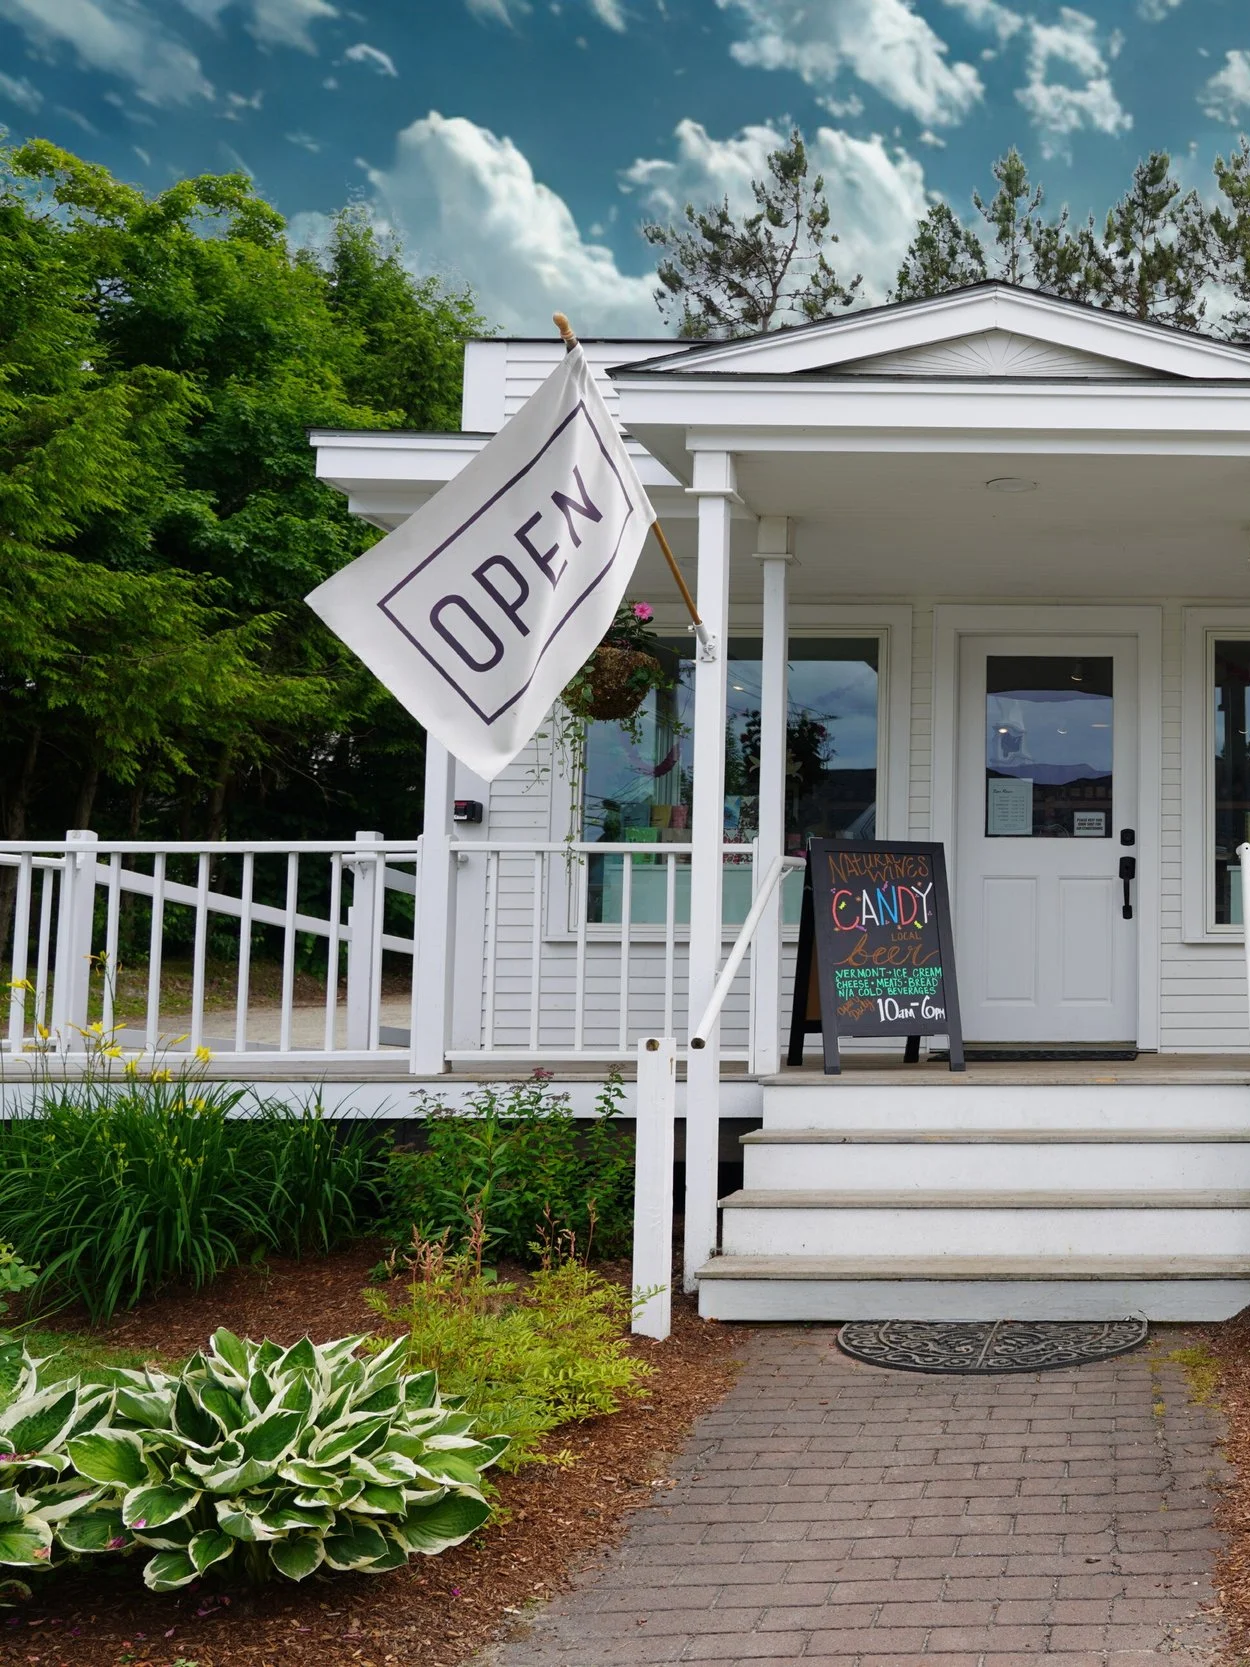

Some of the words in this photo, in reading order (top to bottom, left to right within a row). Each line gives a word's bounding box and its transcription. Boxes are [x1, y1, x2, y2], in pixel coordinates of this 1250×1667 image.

[429, 465, 603, 673] OPEN
[867, 855, 929, 883] WINES
[832, 882, 933, 931] CANDY
[890, 930, 922, 942] LOCAL
[833, 932, 939, 967] beer
[893, 967, 907, 978] ICE
[912, 967, 943, 978] CREAM
[836, 979, 869, 990] CHEESE
[876, 977, 903, 989] MEATS
[908, 977, 939, 988] BREAD
[838, 989, 855, 1000] N/A
[858, 988, 883, 997] COLD
[887, 986, 937, 996] BEVERAGES
